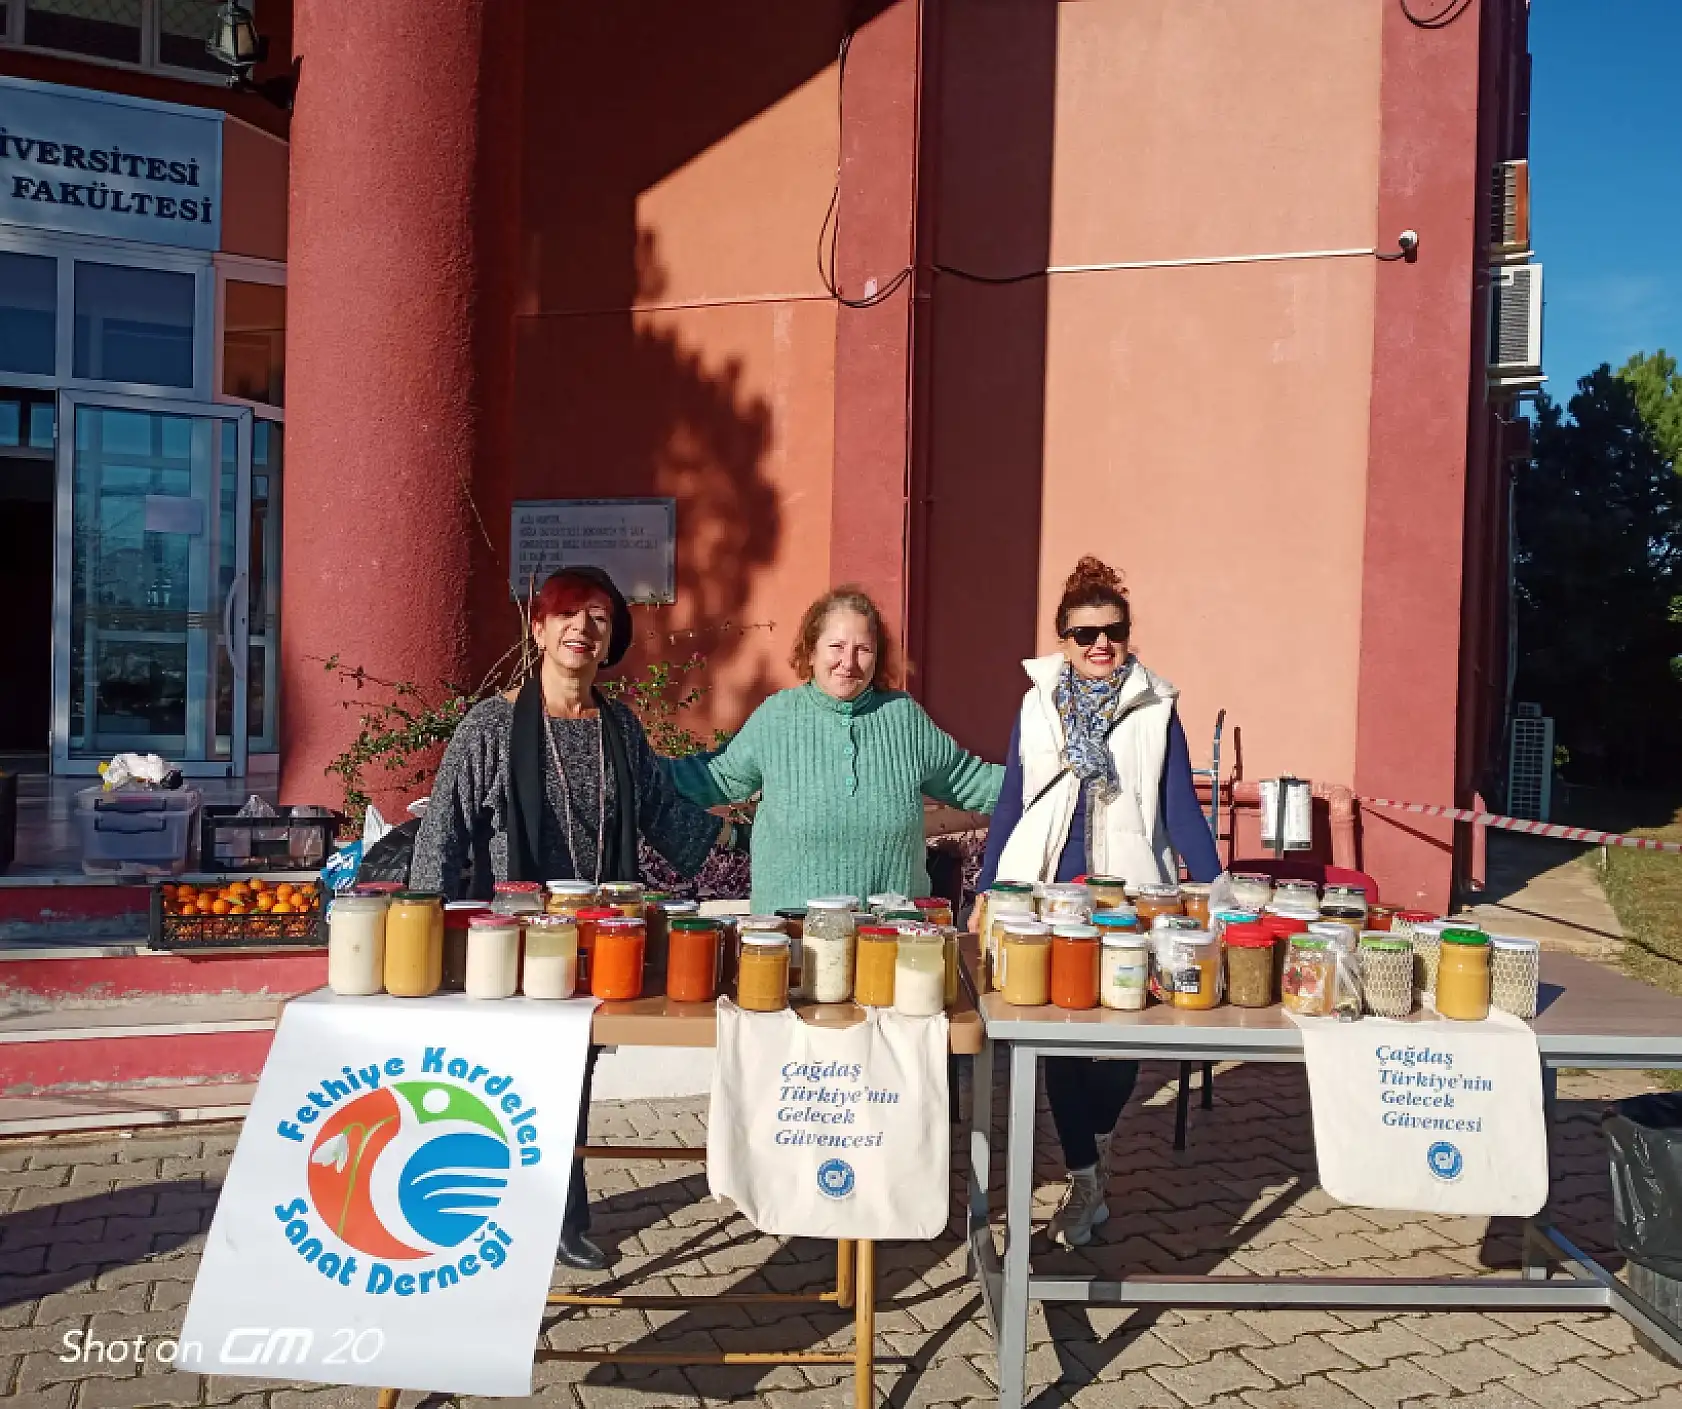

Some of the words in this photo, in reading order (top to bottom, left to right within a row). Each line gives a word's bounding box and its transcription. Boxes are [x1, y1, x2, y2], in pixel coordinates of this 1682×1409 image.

[12, 176, 212, 224] FAKÜLTESİ
[1376, 1045, 1454, 1070] Çağdaş
[781, 1060, 863, 1083] Çağdaş
[1378, 1070, 1492, 1093] Türkiye'nin
[276, 1057, 405, 1142] Fethiye
[421, 1047, 541, 1167] Kardelen
[779, 1086, 900, 1108] Türkiye'nin
[1381, 1090, 1455, 1109] Gelecek
[777, 1106, 855, 1124] Gelecek
[1382, 1110, 1482, 1132] Güvencesi
[774, 1129, 884, 1148] Güvencesi
[274, 1197, 358, 1286] Sanat
[365, 1221, 514, 1297] Derneği
